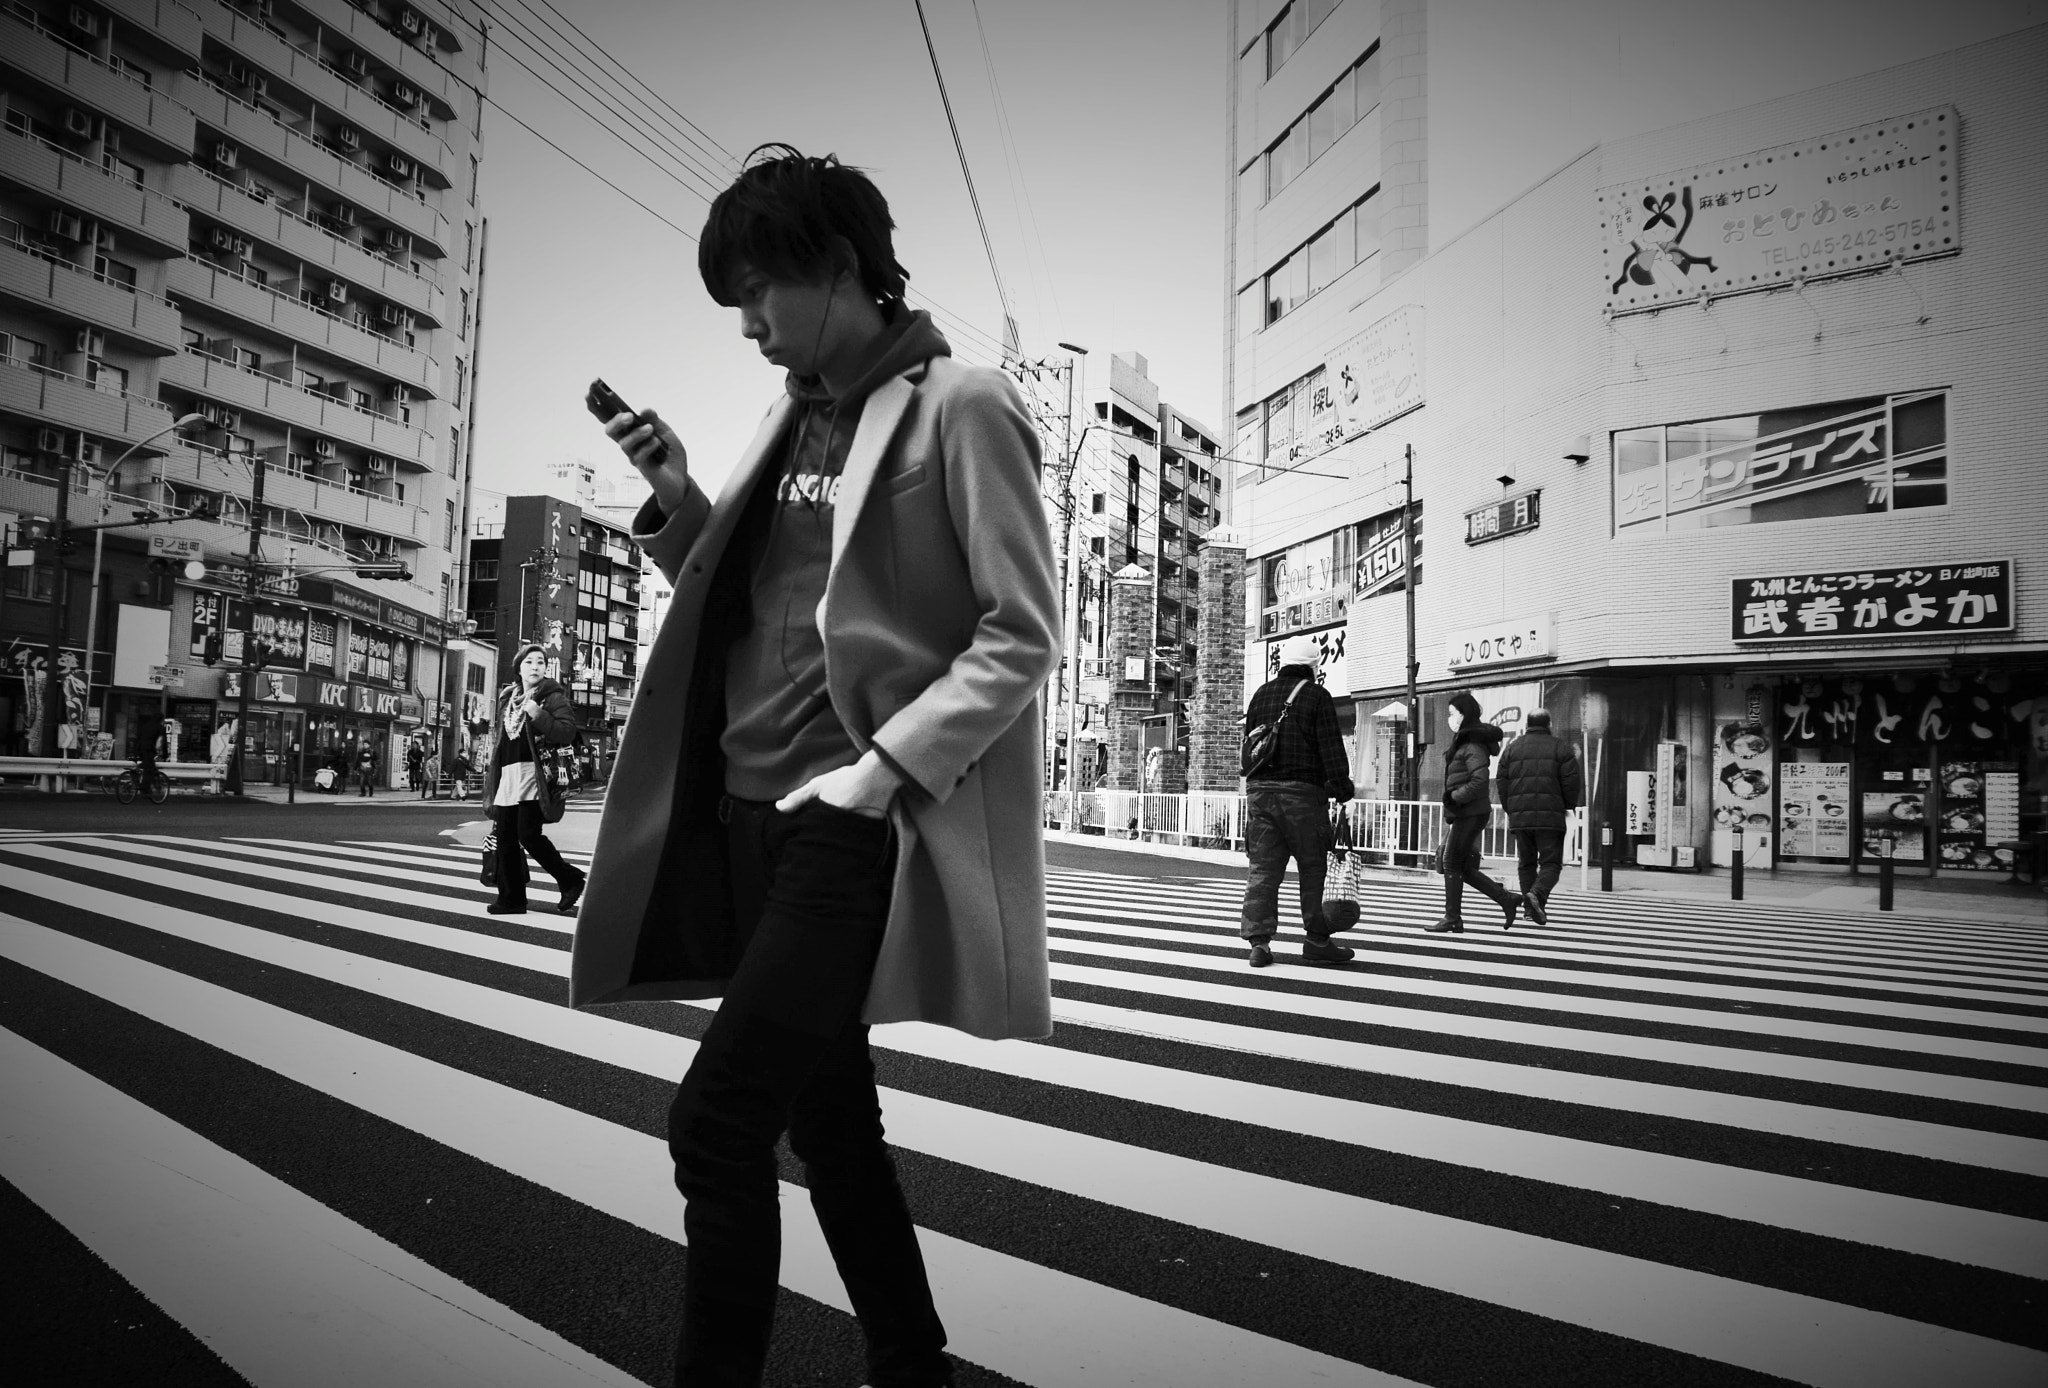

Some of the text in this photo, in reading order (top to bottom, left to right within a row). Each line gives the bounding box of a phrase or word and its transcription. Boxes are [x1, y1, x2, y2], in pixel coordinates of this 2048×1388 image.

[1699, 183, 1778, 210] 麻雀サロン
[1722, 196, 1900, 244] おとひめちゃん
[1670, 418, 1887, 504] サンライズ
[1382, 517, 1402, 539] 仕上げ
[1470, 497, 1529, 538] 時間 月
[154, 538, 200, 552] 日ノ出町
[1274, 556, 1331, 598] Coty
[1751, 565, 2001, 597] 九州とんこつラーメン 日ノ出町店
[195, 595, 217, 608] 受付
[1743, 589, 1998, 635] 武者がよか
[194, 606, 217, 625] 2F
[253, 614, 305, 638] DVD・まんが
[227, 633, 243, 648] 24
[1464, 634, 1522, 662] ひのでや
[320, 682, 347, 706] KFC
[376, 693, 400, 716] KFC
[1630, 804, 1638, 831] ひのでや
